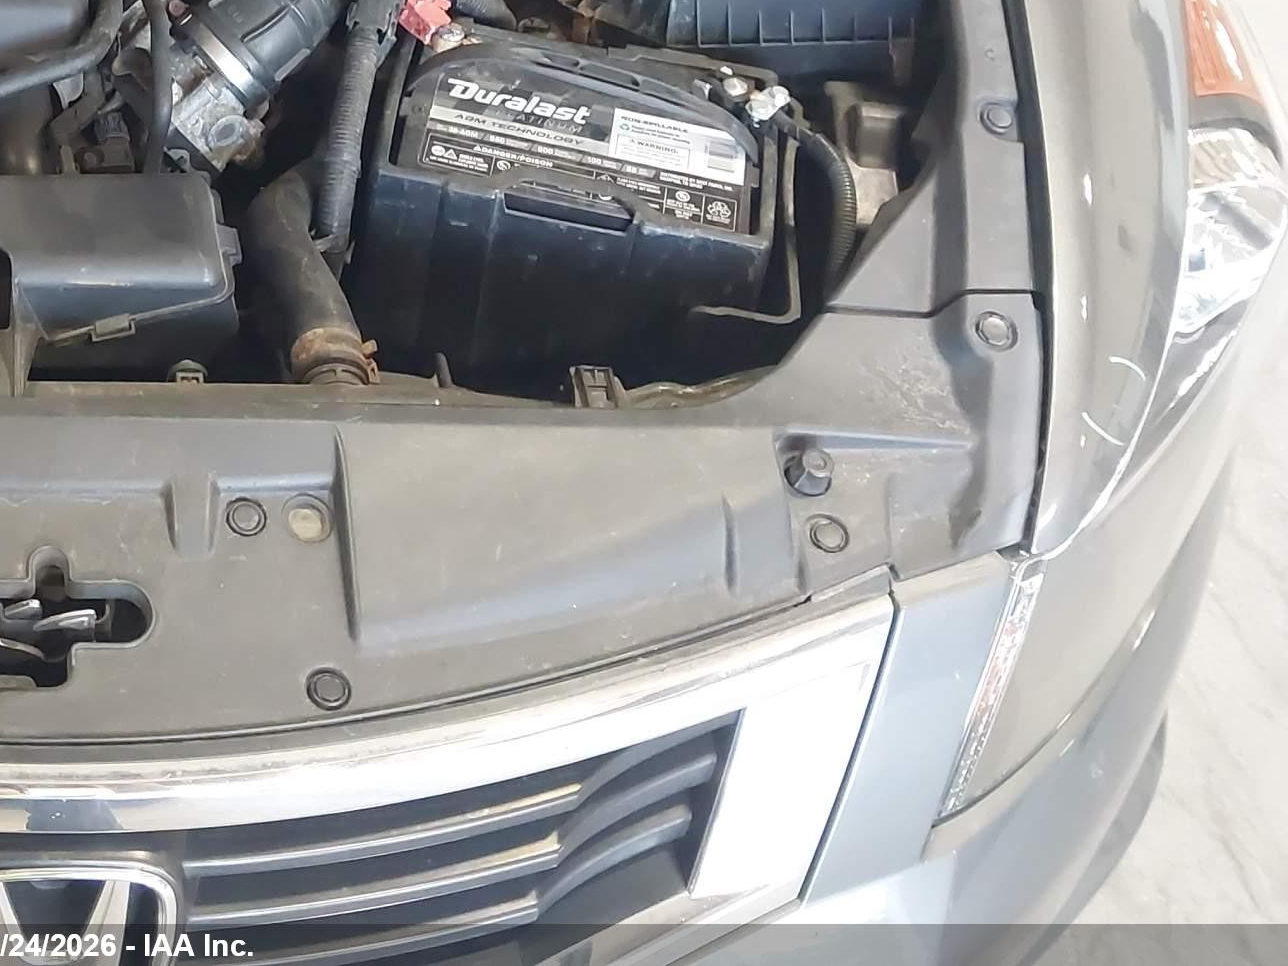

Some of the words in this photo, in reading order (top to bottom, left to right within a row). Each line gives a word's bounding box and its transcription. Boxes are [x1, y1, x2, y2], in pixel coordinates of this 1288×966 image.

[448, 78, 591, 124] Duralast
[491, 120, 585, 145] TECHNOLOGY
[621, 115, 689, 133] NON-SPILLABLE
